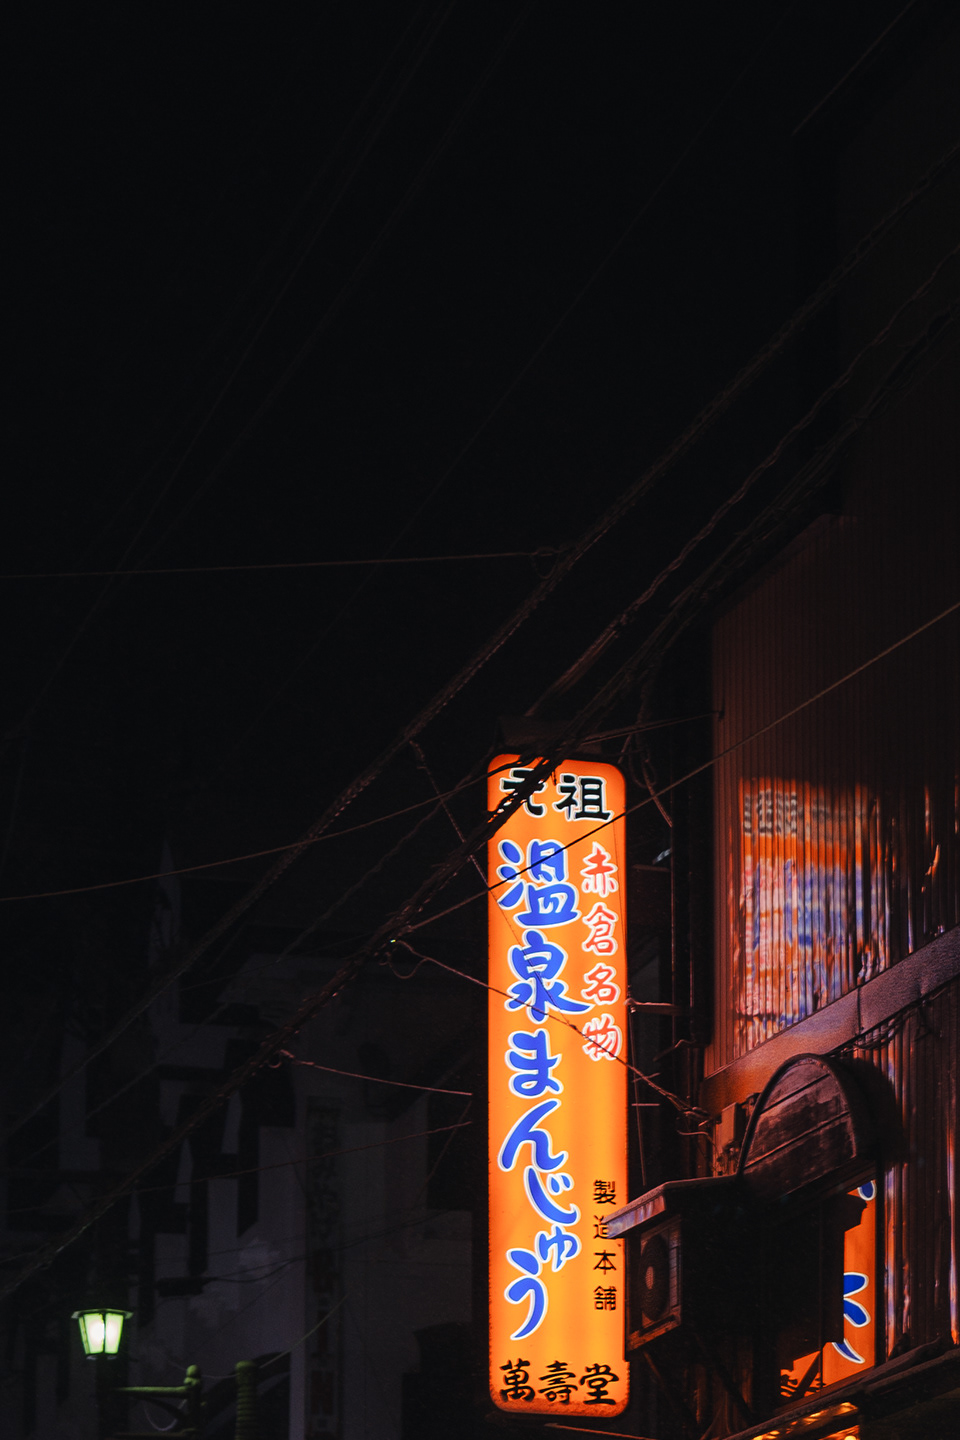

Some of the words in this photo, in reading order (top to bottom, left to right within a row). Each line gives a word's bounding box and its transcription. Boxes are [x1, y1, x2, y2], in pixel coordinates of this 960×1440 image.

[500, 767, 614, 822] 元祖
[580, 841, 623, 1062] 赤倉名物
[496, 839, 595, 1341] 温泉まんじゅう
[592, 1178, 617, 1312] 製造本舗
